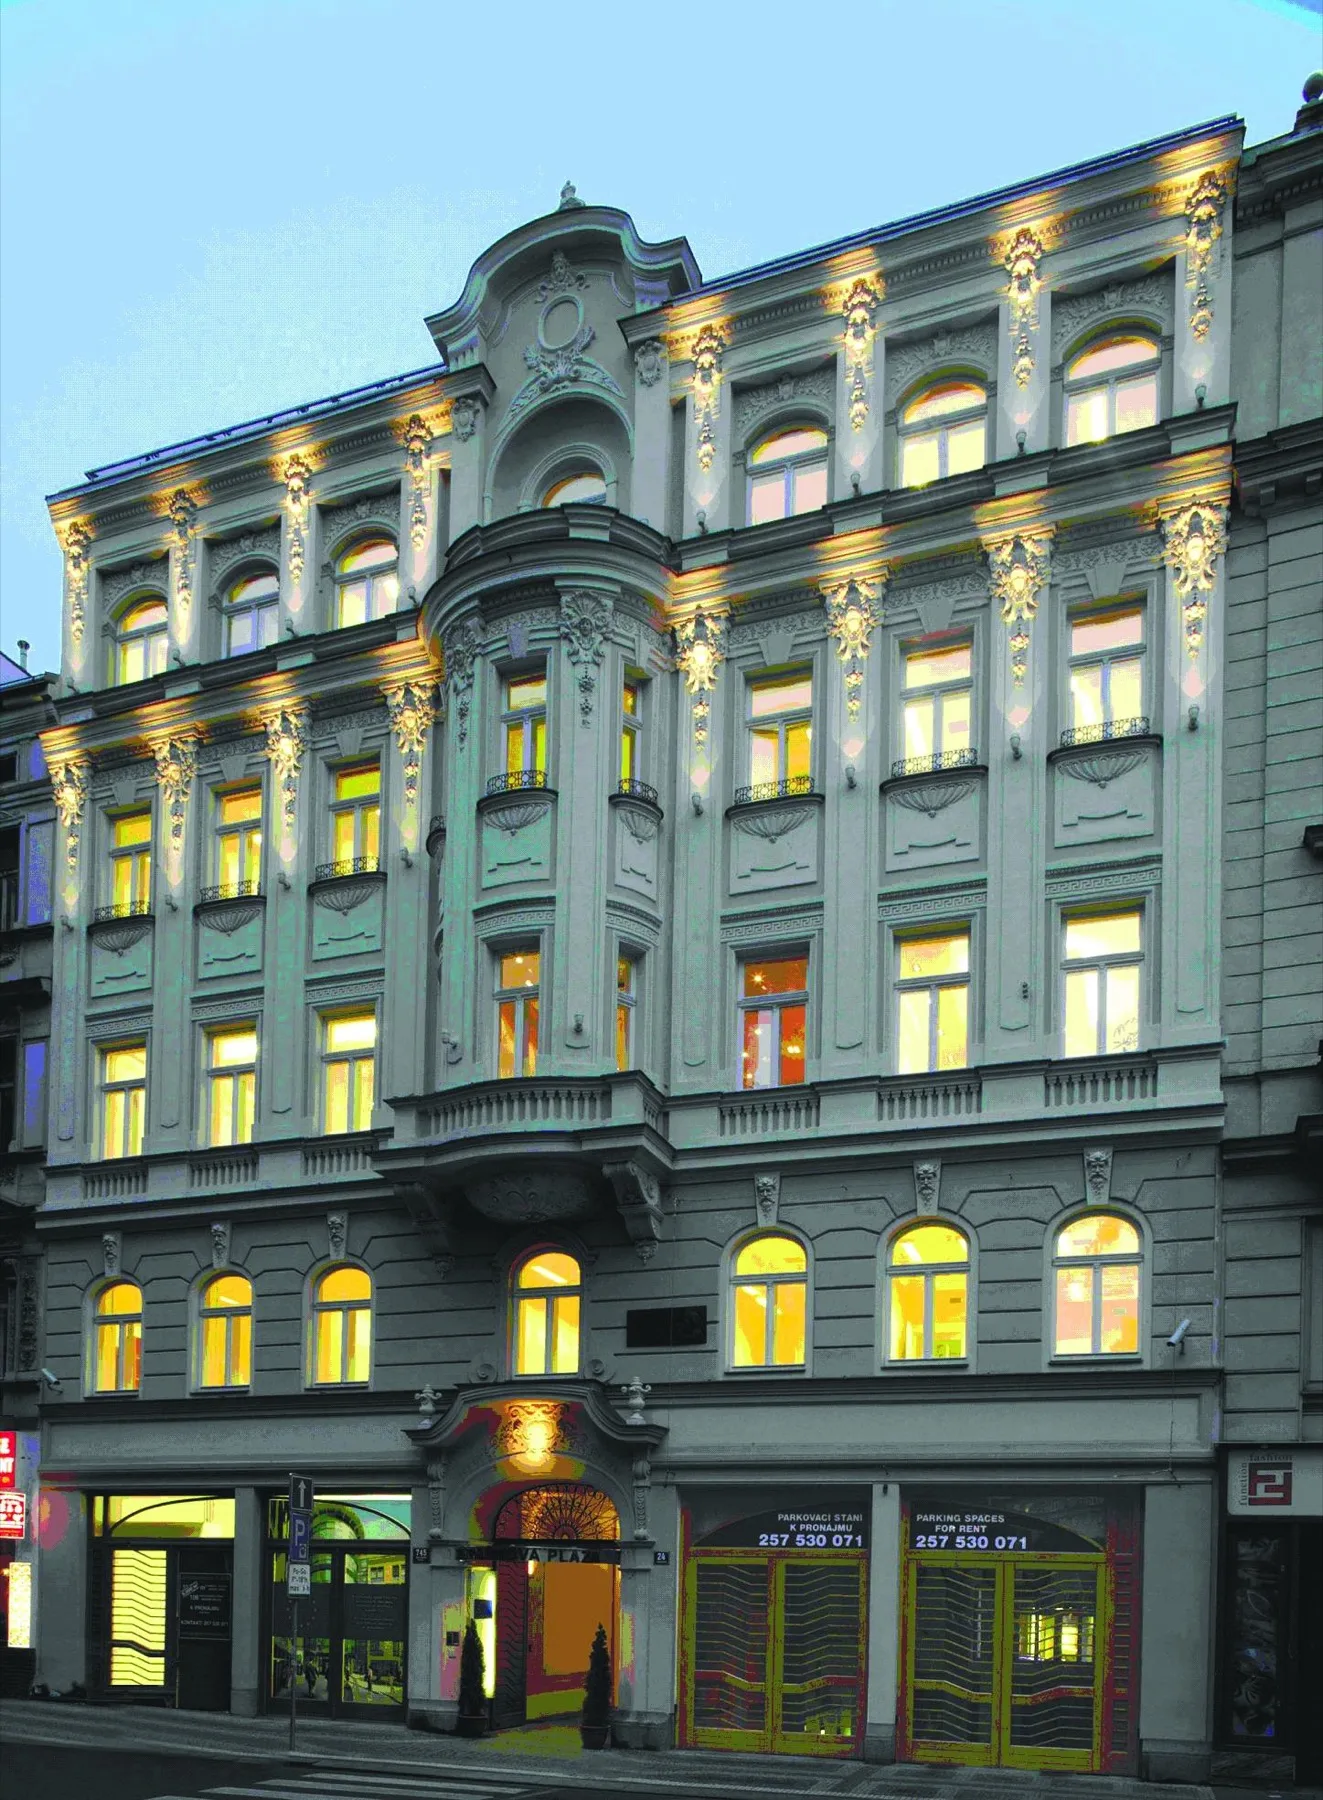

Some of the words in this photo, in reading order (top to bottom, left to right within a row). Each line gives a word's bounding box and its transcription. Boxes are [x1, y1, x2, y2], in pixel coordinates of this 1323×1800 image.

[1249, 1452, 1292, 1462] fashion
[1239, 1462, 1248, 1506] function
[916, 1514, 961, 1522] PARKING
[964, 1514, 1005, 1523] SPACES
[789, 1524, 797, 1532] K
[935, 1525, 956, 1533] FOR
[959, 1525, 987, 1533] RENT
[759, 1534, 788, 1547] 257
[795, 1534, 827, 1547] 530
[832, 1534, 863, 1547] 071
[916, 1535, 949, 1548] 257
[955, 1535, 989, 1549] 530
[994, 1536, 1027, 1549] 071
[657, 1552, 666, 1560] 24
